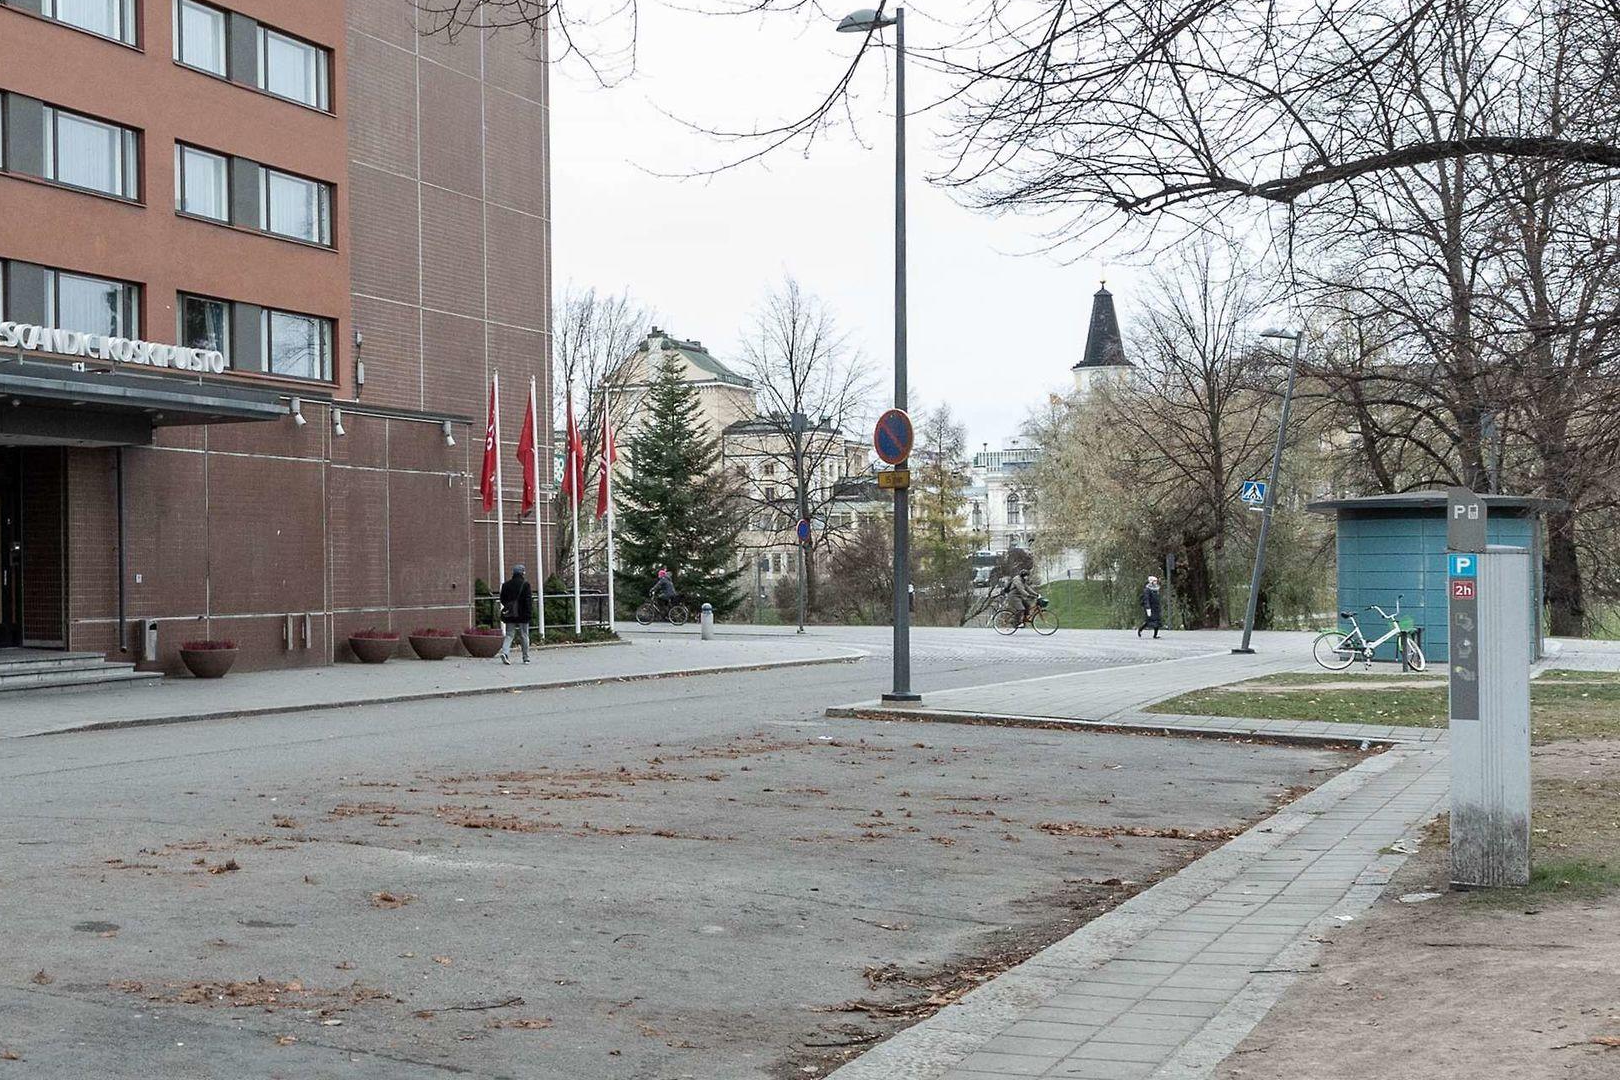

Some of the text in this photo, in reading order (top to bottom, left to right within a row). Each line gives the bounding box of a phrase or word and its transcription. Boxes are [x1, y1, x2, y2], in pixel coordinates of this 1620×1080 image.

[99, 336, 225, 374] KOSKIPUISTO
[1454, 505, 1466, 520] P
[1456, 557, 1471, 574] P
[1455, 585, 1472, 596] 2h
